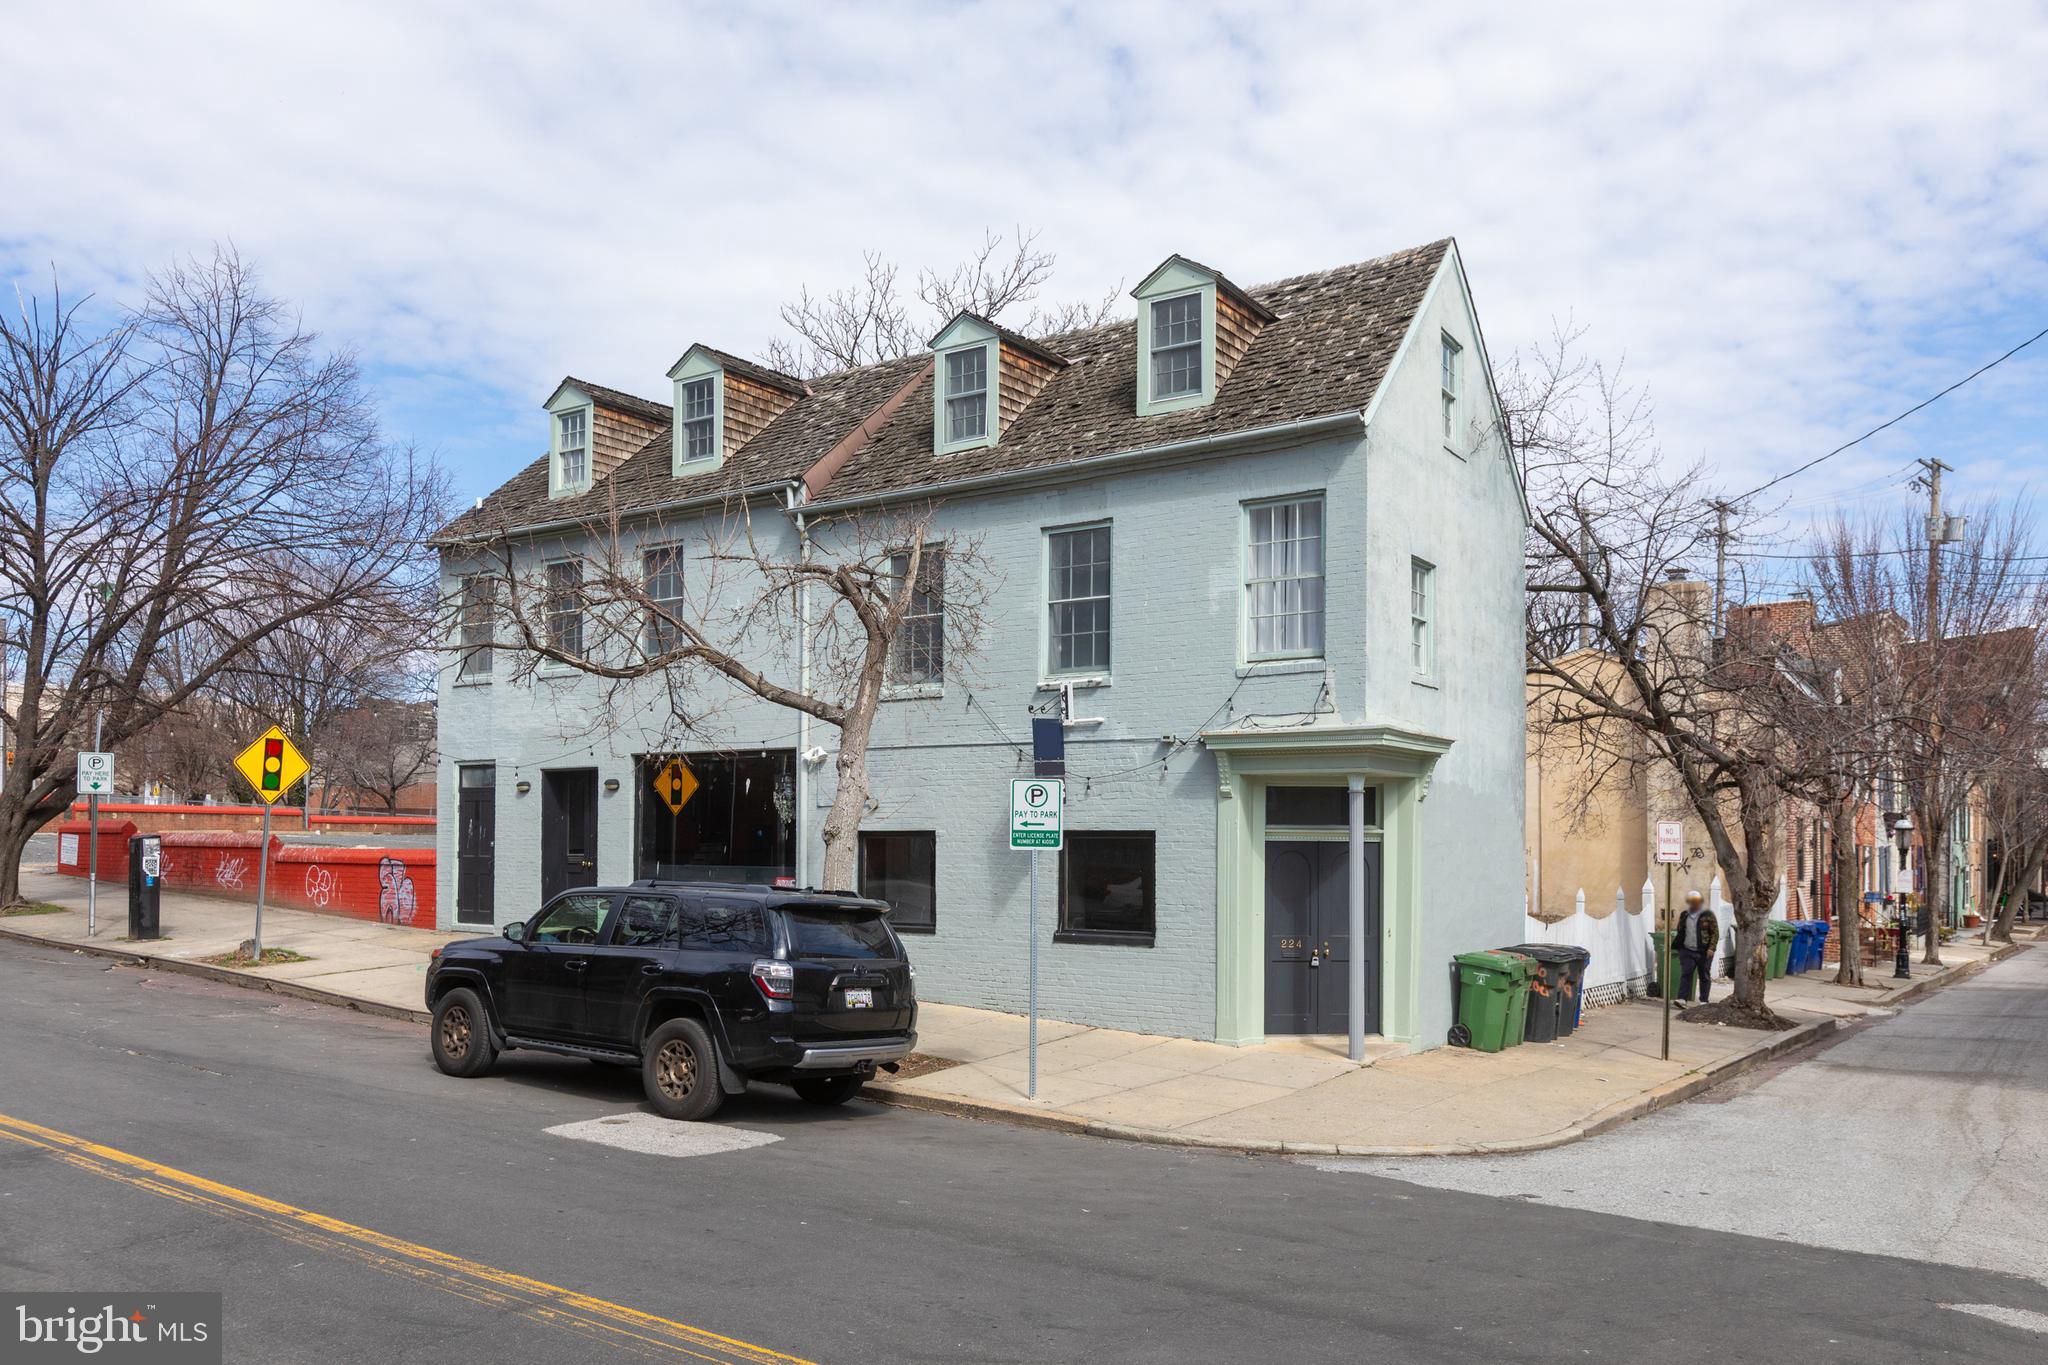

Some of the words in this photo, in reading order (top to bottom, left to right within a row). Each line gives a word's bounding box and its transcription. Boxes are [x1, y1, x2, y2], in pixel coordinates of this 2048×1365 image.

[92, 759, 101, 768] P
[1031, 788, 1044, 804] P
[1015, 810, 1028, 818] PAY
[1660, 837, 1679, 845] PARKING
[1281, 939, 1302, 949] 224
